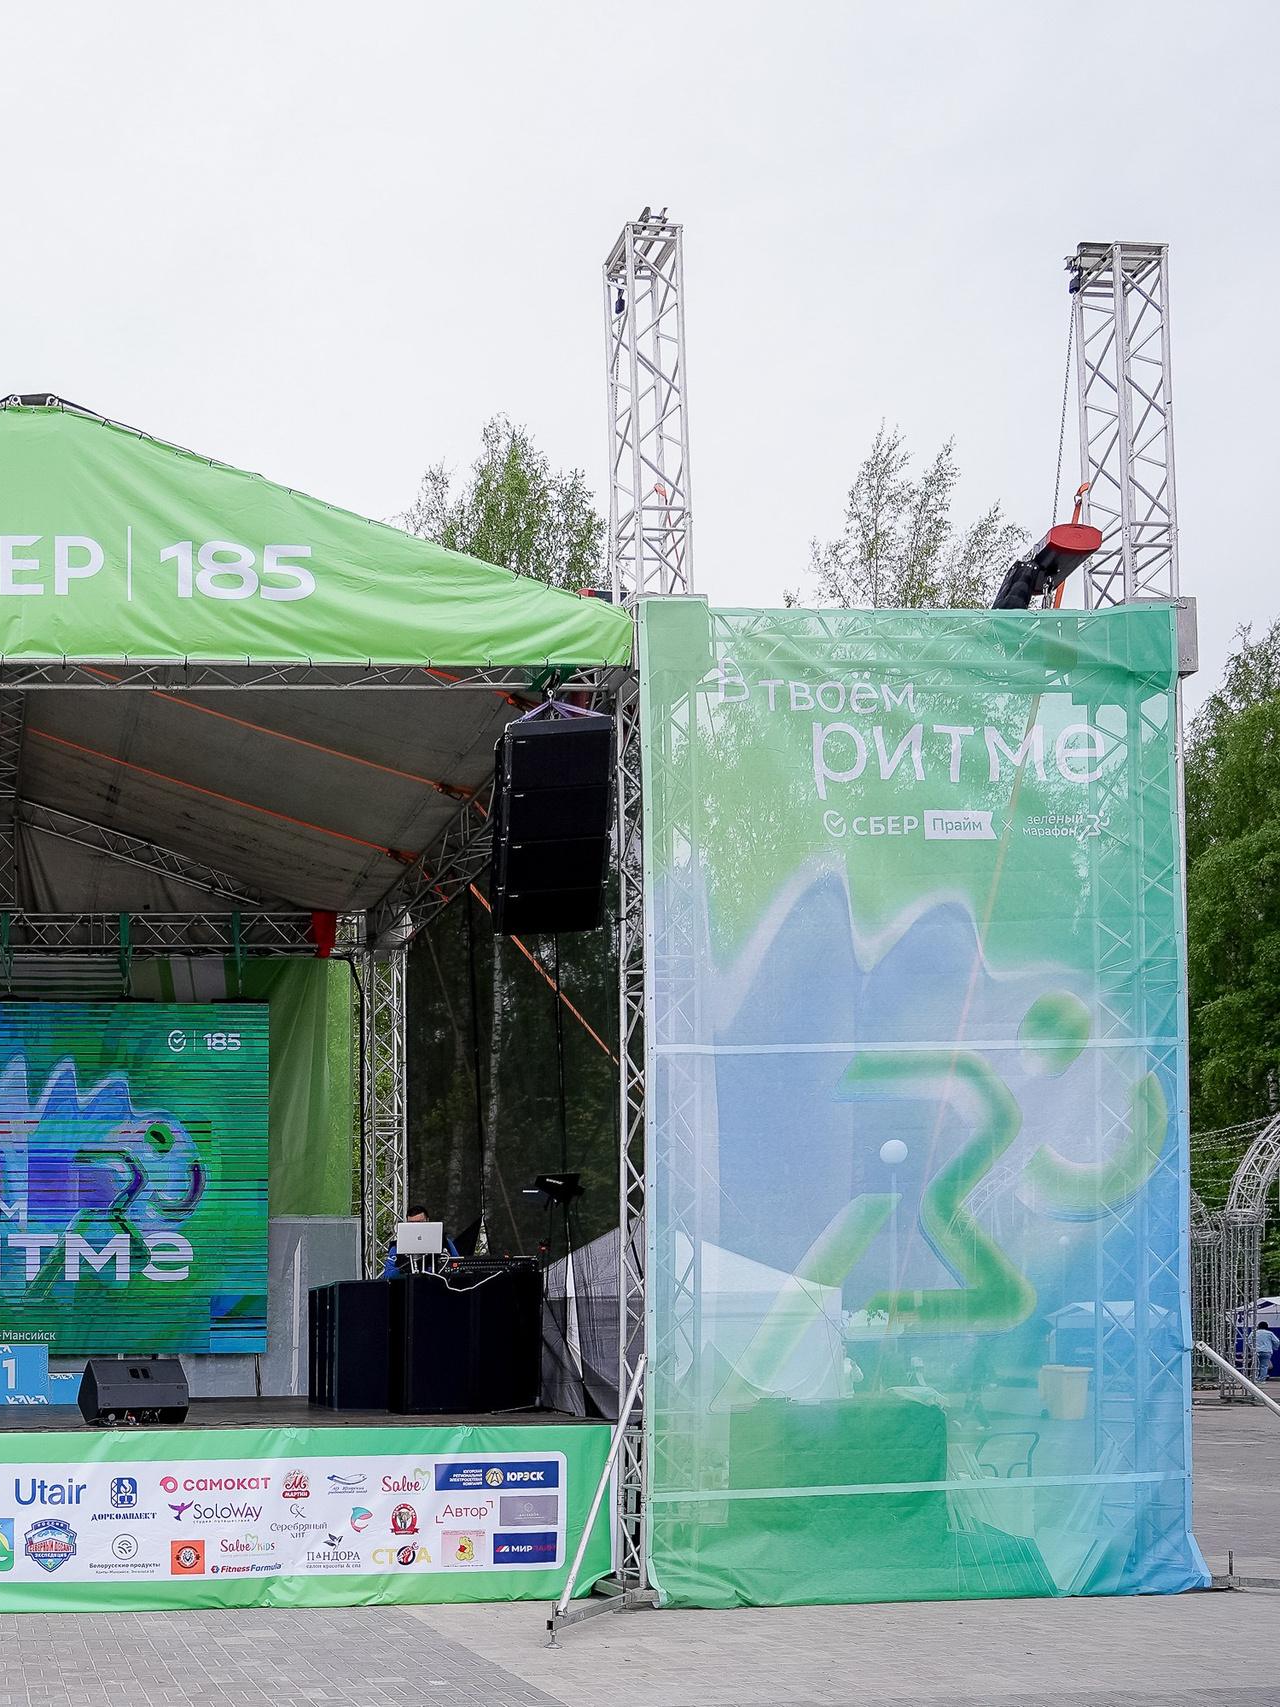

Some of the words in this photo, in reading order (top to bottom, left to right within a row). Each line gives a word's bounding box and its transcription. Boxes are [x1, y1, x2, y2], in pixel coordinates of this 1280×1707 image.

[160, 540, 317, 602] 185
[720, 658, 751, 703] В
[759, 671, 916, 715] твоём
[812, 721, 1107, 801] ритме
[1026, 810, 1084, 825] зелёный
[852, 815, 919, 837] СБЕР
[932, 816, 984, 834] Прайм
[1022, 825, 1078, 839] марафон
[203, 1032, 242, 1051] 185
[2, 1358, 17, 1390] 1
[381, 1475, 422, 1492] Salve
[506, 1471, 545, 1482] ЮРЭСК
[14, 1478, 87, 1506] Utair
[183, 1477, 271, 1492] самокат
[91, 1512, 158, 1522] ДОРКОМПЛЕКТ
[442, 1504, 488, 1519] Автор
[270, 1522, 328, 1532] Серебряный
[220, 1539, 252, 1552] Salve
[89, 1562, 130, 1570] Белорусские
